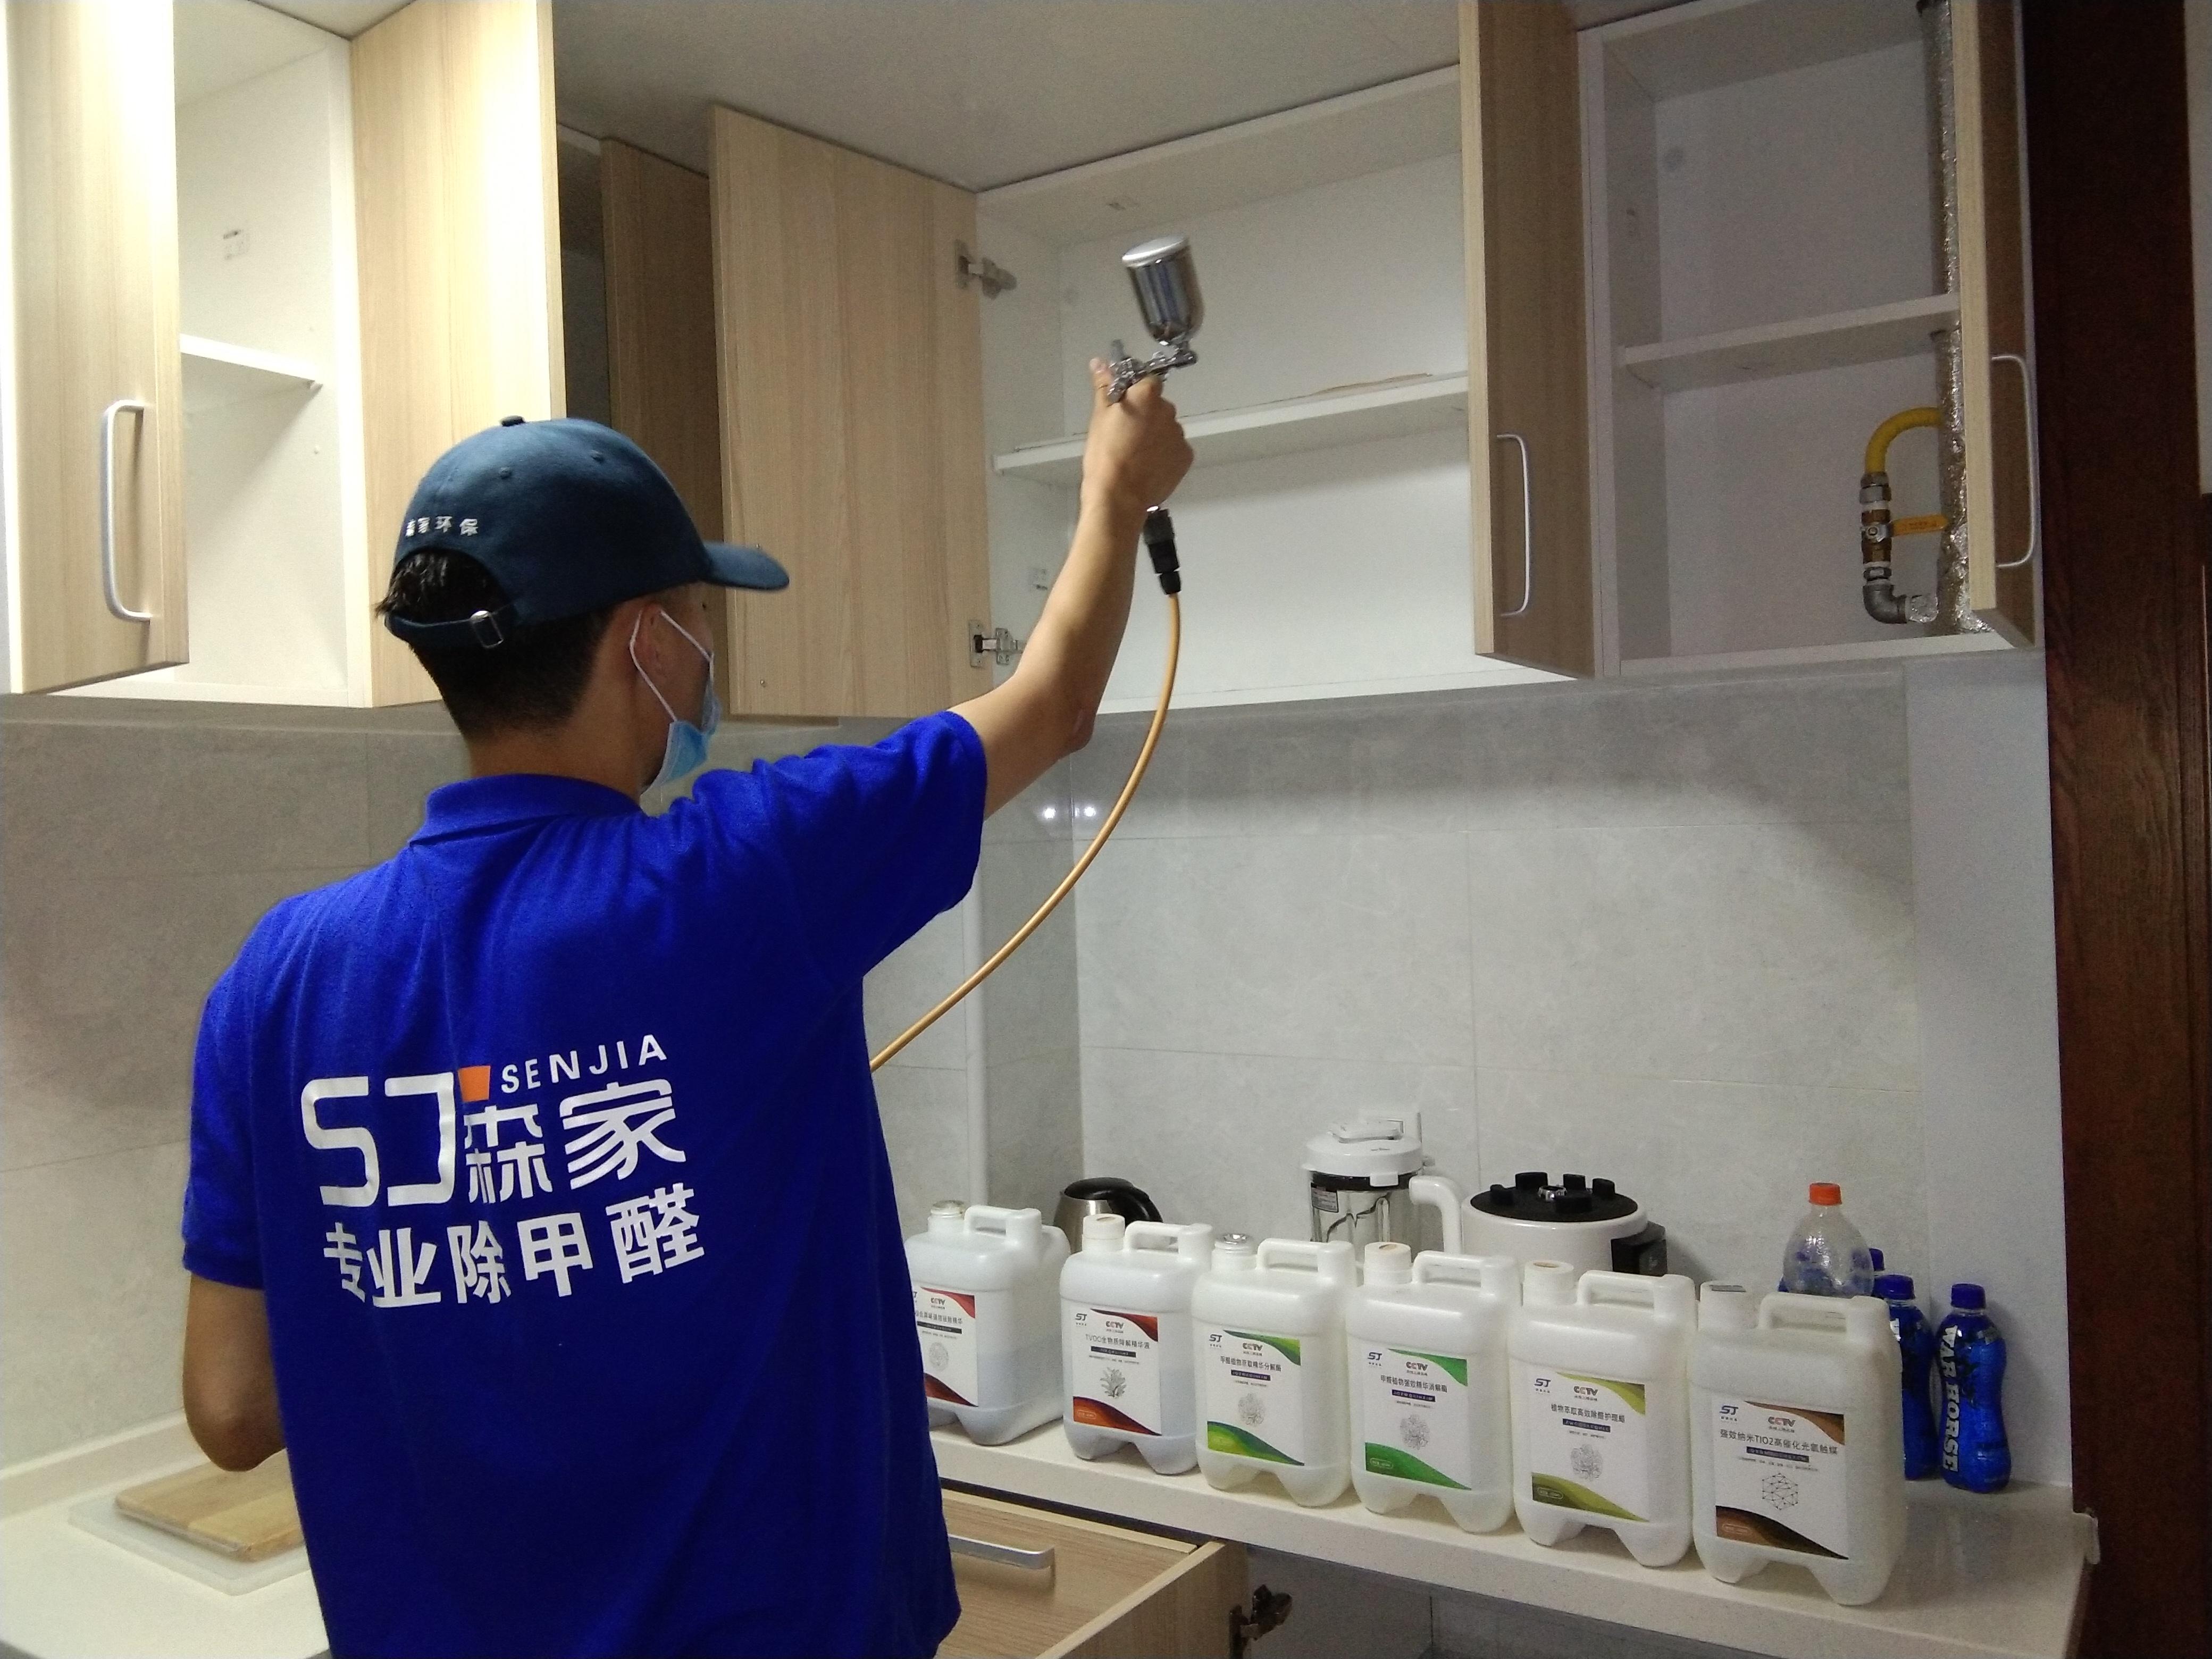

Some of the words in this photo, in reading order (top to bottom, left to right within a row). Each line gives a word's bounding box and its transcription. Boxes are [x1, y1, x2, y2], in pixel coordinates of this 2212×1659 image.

[501, 1035, 667, 1093] SENJIA
[464, 1079, 686, 1204] 森家
[324, 1182, 704, 1308] 专业除甲醛
[1105, 1321, 1125, 1329] CCTV
[1242, 1343, 1263, 1351] CCTV
[1940, 1325, 1958, 1378] WAR
[1406, 1361, 1428, 1371] CCTV
[1574, 1386, 1598, 1396] CCTV
[1767, 1416, 1796, 1427] CCTV
[1942, 1381, 1960, 1472] HORSE
